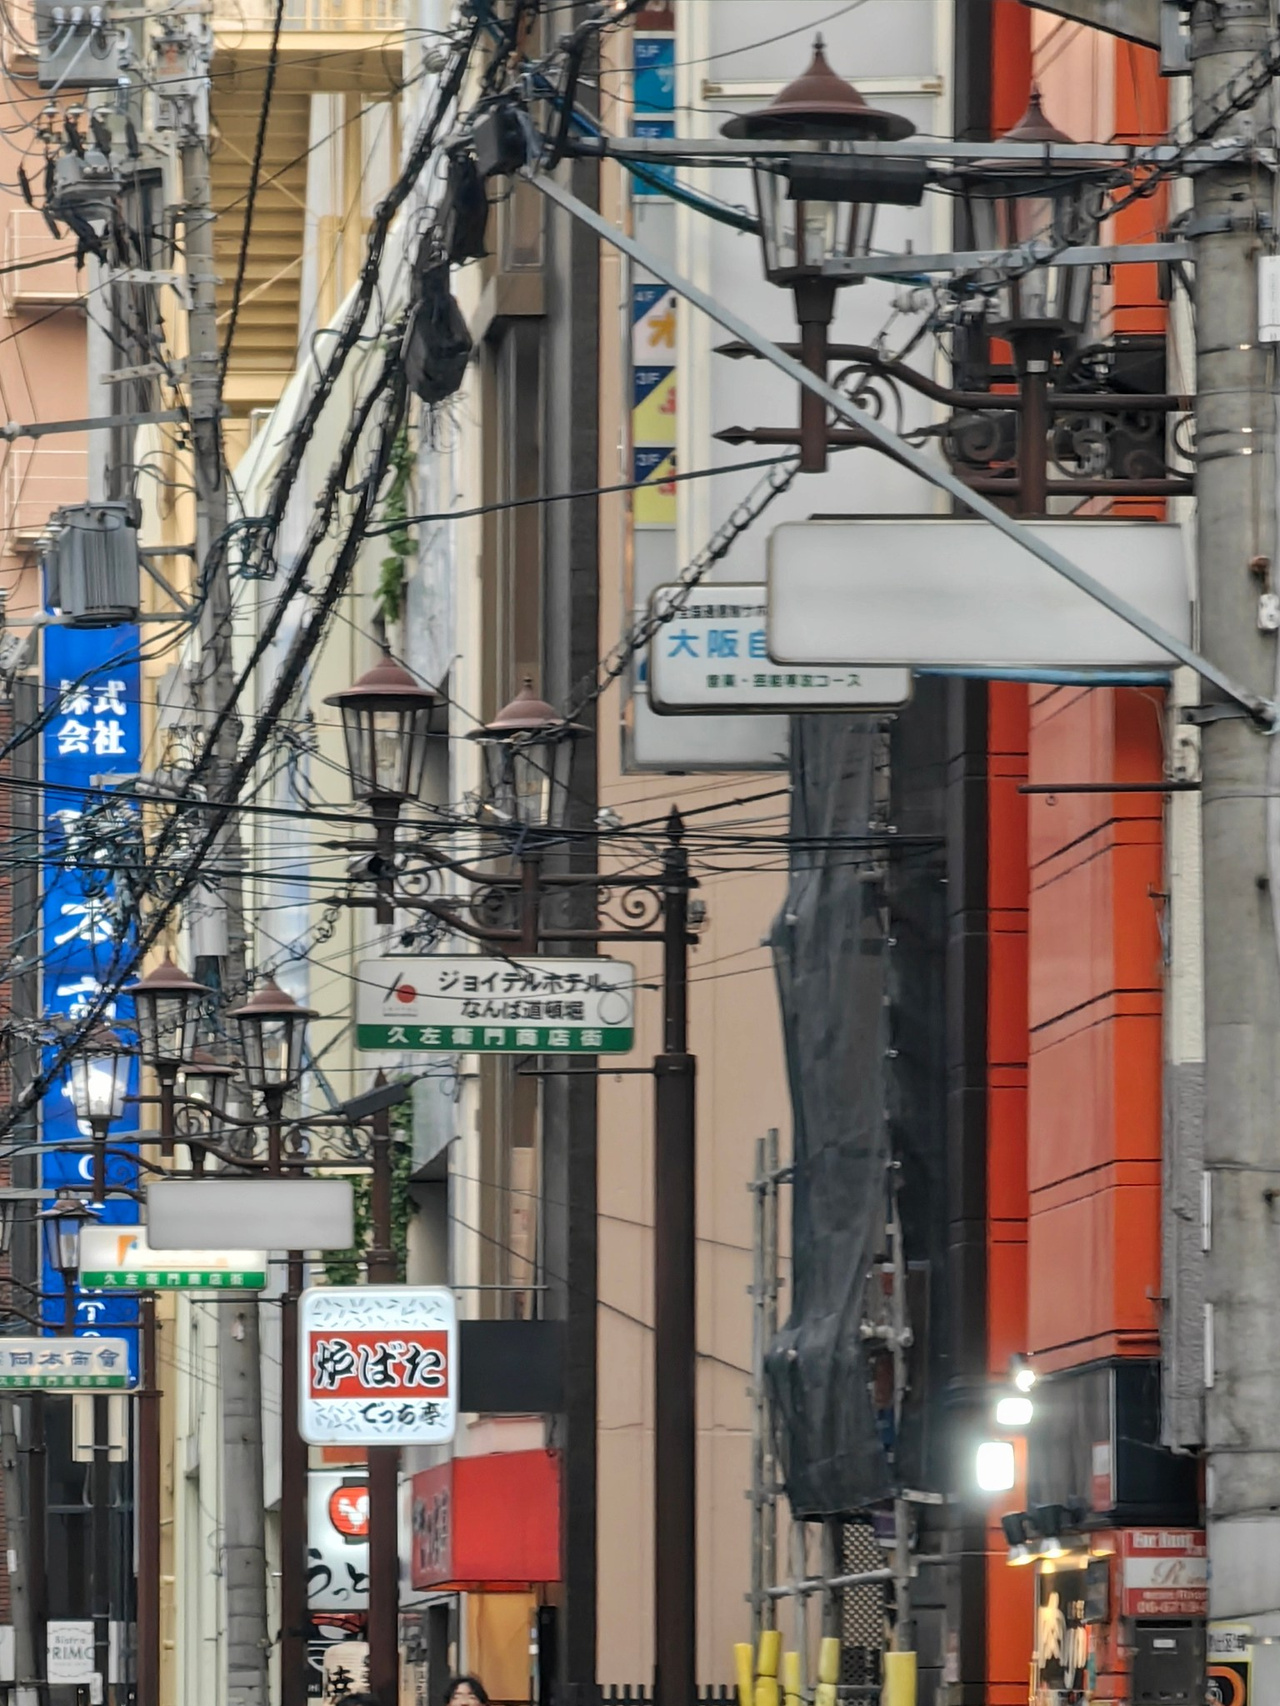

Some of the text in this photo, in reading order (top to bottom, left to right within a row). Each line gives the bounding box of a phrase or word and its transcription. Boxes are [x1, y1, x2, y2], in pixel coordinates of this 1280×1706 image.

[58, 679, 127, 716] 株式
[57, 718, 127, 756] 会社
[460, 1000, 585, 1020] なんば道頓堀
[387, 1026, 604, 1046] 久左衛門商店街
[314, 1339, 444, 1389] 炉ばた
